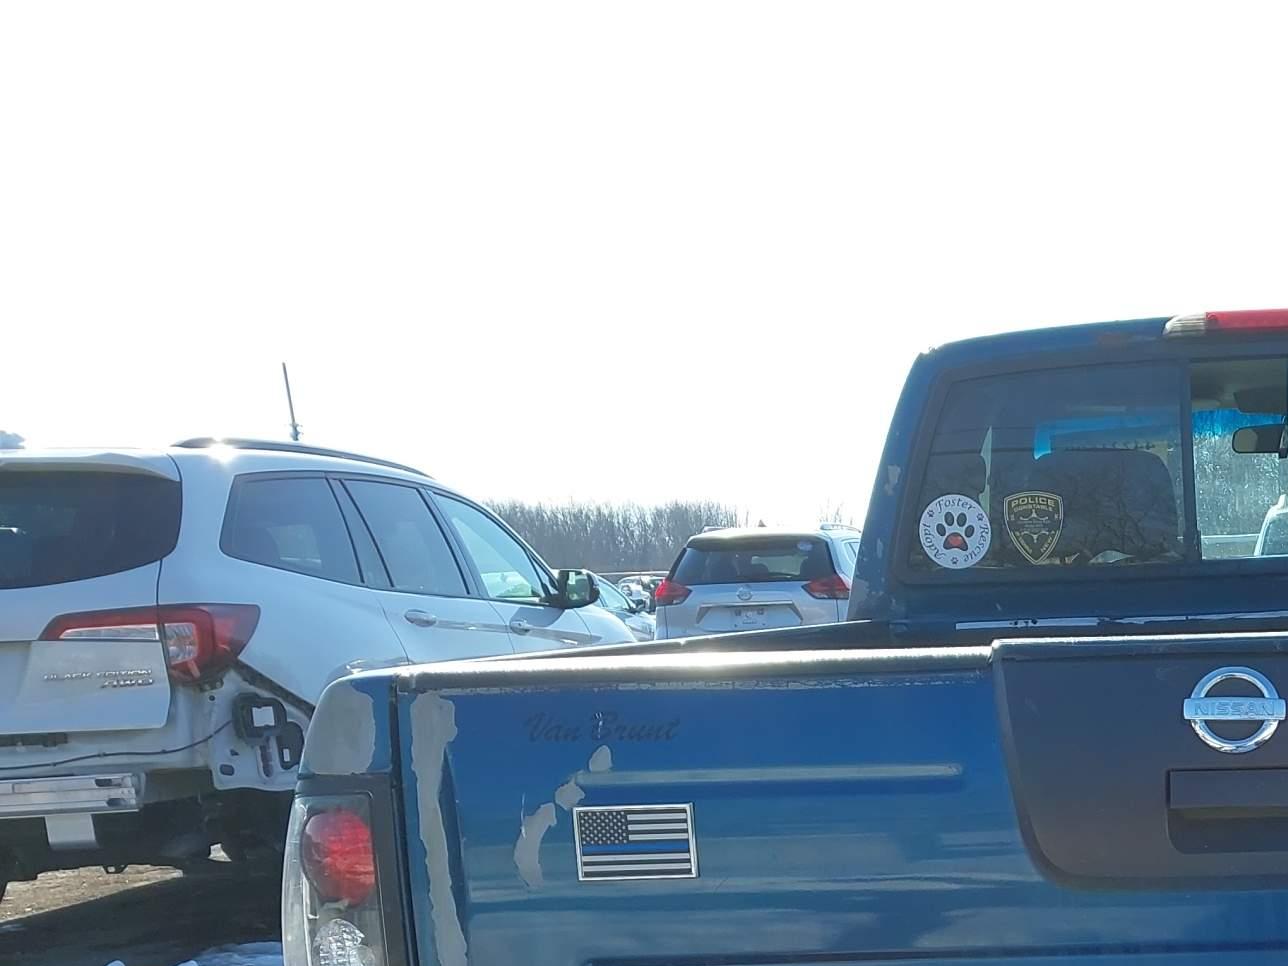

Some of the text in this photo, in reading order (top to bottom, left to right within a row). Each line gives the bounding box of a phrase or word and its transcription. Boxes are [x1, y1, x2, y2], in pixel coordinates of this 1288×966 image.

[935, 498, 977, 514] Foster
[1011, 496, 1056, 508] POLICE
[922, 522, 946, 560] Adopt
[963, 522, 989, 562] Rescue
[1194, 701, 1275, 717] NISSAN
